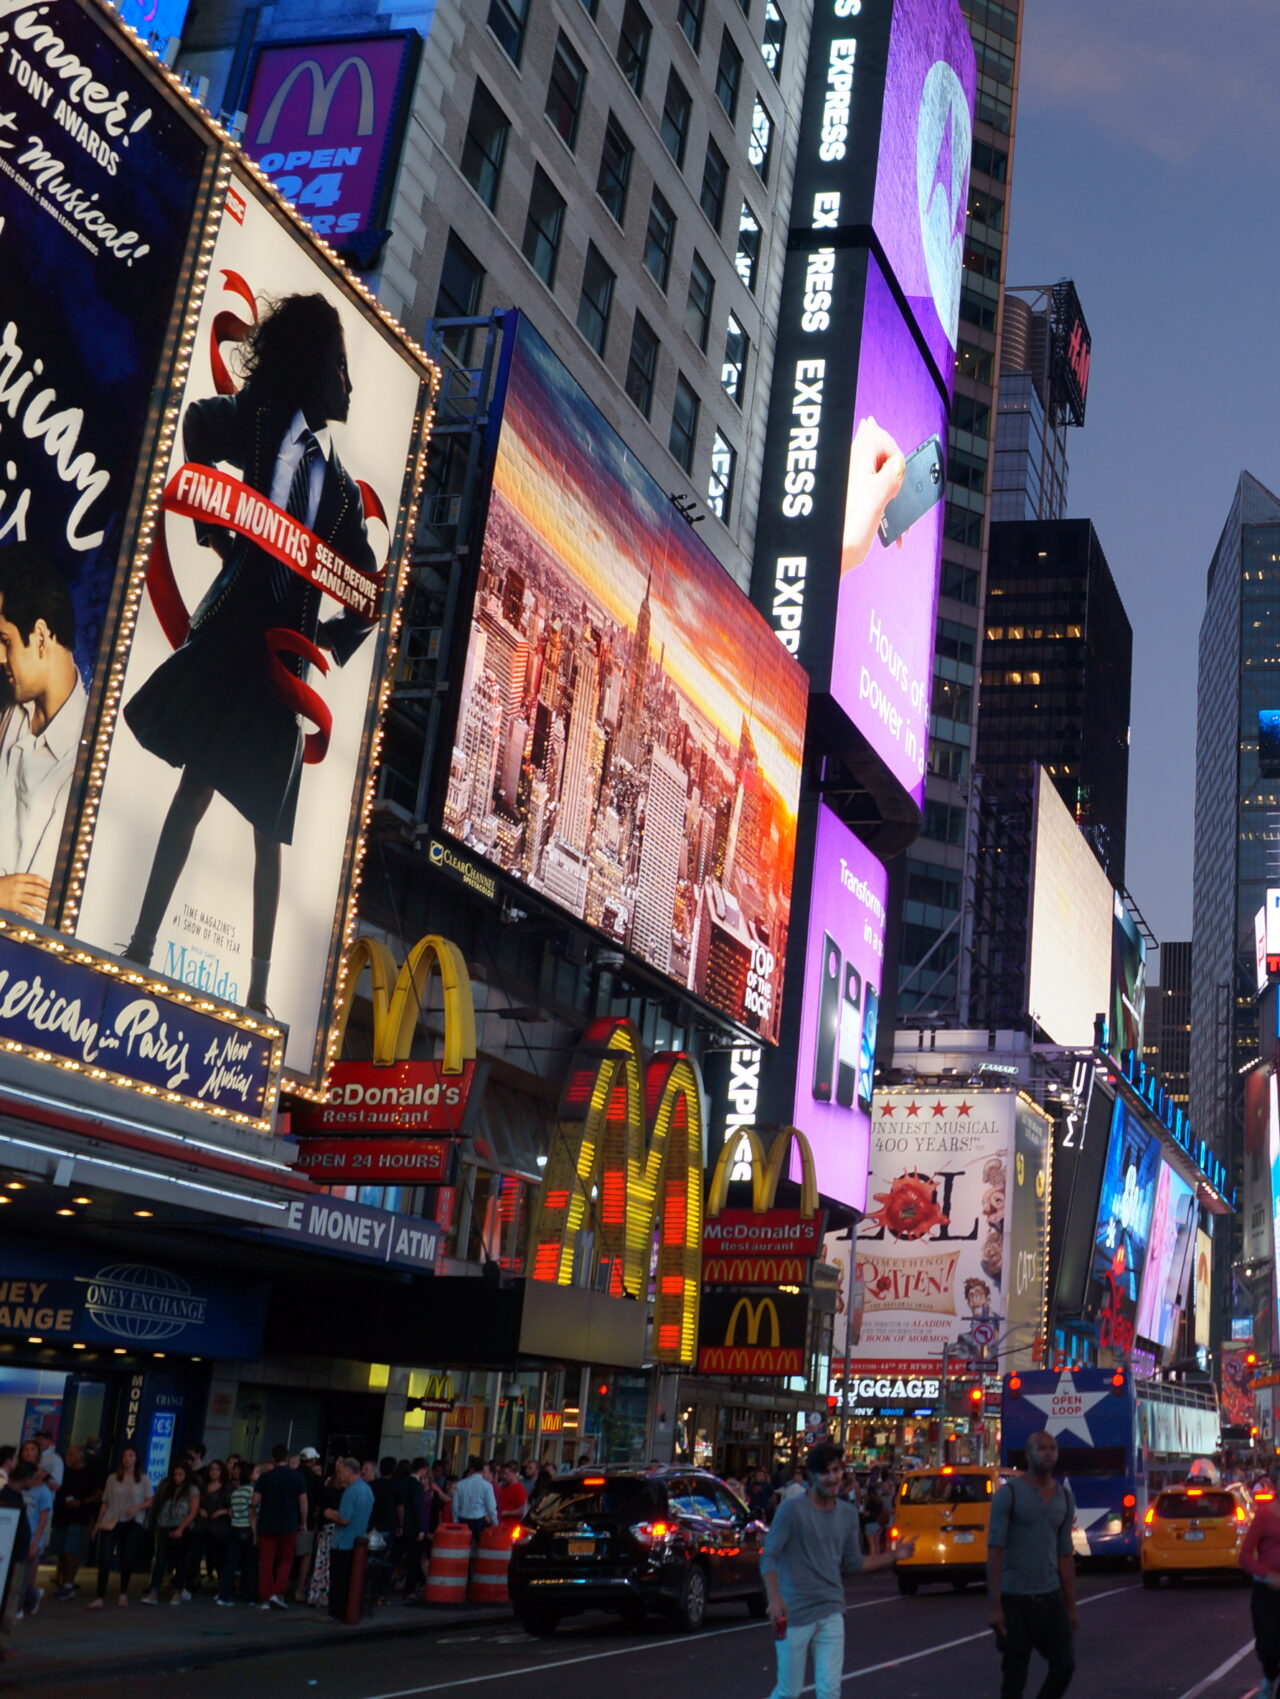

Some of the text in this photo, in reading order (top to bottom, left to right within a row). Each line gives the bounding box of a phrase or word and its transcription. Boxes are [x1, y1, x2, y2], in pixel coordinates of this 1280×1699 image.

[4, 3, 152, 147] inner!
[8, 48, 120, 176] TONY AWARDS
[818, 38, 856, 162] EXPRESS
[260, 147, 362, 172] OPEN
[14, 173, 36, 197] CIRCLE
[17, 136, 150, 267] Musical!
[782, 358, 826, 518] EXPRESS
[177, 469, 311, 568] FINAL MONTHS
[311, 563, 368, 612] JANUARY
[315, 543, 378, 600] SEE IT BEFORE
[869, 608, 925, 710] Hours of
[859, 665, 903, 741] power
[906, 719, 917, 764] in
[840, 859, 882, 919] Transform
[183, 904, 236, 938] TIME MAGAZINE'S
[183, 919, 201, 935] SHOW
[203, 928, 212, 941] OF
[213, 933, 224, 947] THE
[226, 940, 241, 954] YEAR
[863, 918, 873, 941] in
[163, 940, 238, 1003] Matilda
[749, 941, 774, 978] TOP
[746, 970, 772, 998] OF THE
[744, 988, 773, 1020] ROCK
[99, 1029, 119, 1049] in
[114, 999, 190, 1089] Paris
[220, 1031, 252, 1062] New
[199, 1066, 253, 1101] Musical
[322, 1109, 430, 1123] Restaurant
[872, 1120, 999, 1135] UNNIEST MUSICAL
[299, 1153, 440, 1169] OPEN 24 HOURS
[875, 1138, 909, 1152] 400
[308, 1205, 436, 1261] MONEY ATM
[703, 1223, 814, 1239] McDonald's
[720, 1242, 794, 1251] Restaurant
[864, 1255, 944, 1267] SOMETHING
[1016, 1250, 1037, 1296] CATS
[856, 1259, 956, 1301] ROTTEN!
[130, 1291, 207, 1321] EXCHANGE
[907, 1334, 950, 1343] MORMON
[911, 1319, 952, 1328] ALADDIN
[829, 1379, 940, 1398] LUGGAGE
[1052, 1396, 1082, 1405] OPEN
[125, 1374, 144, 1440] MONEY
[1052, 1407, 1082, 1415] LOOP
